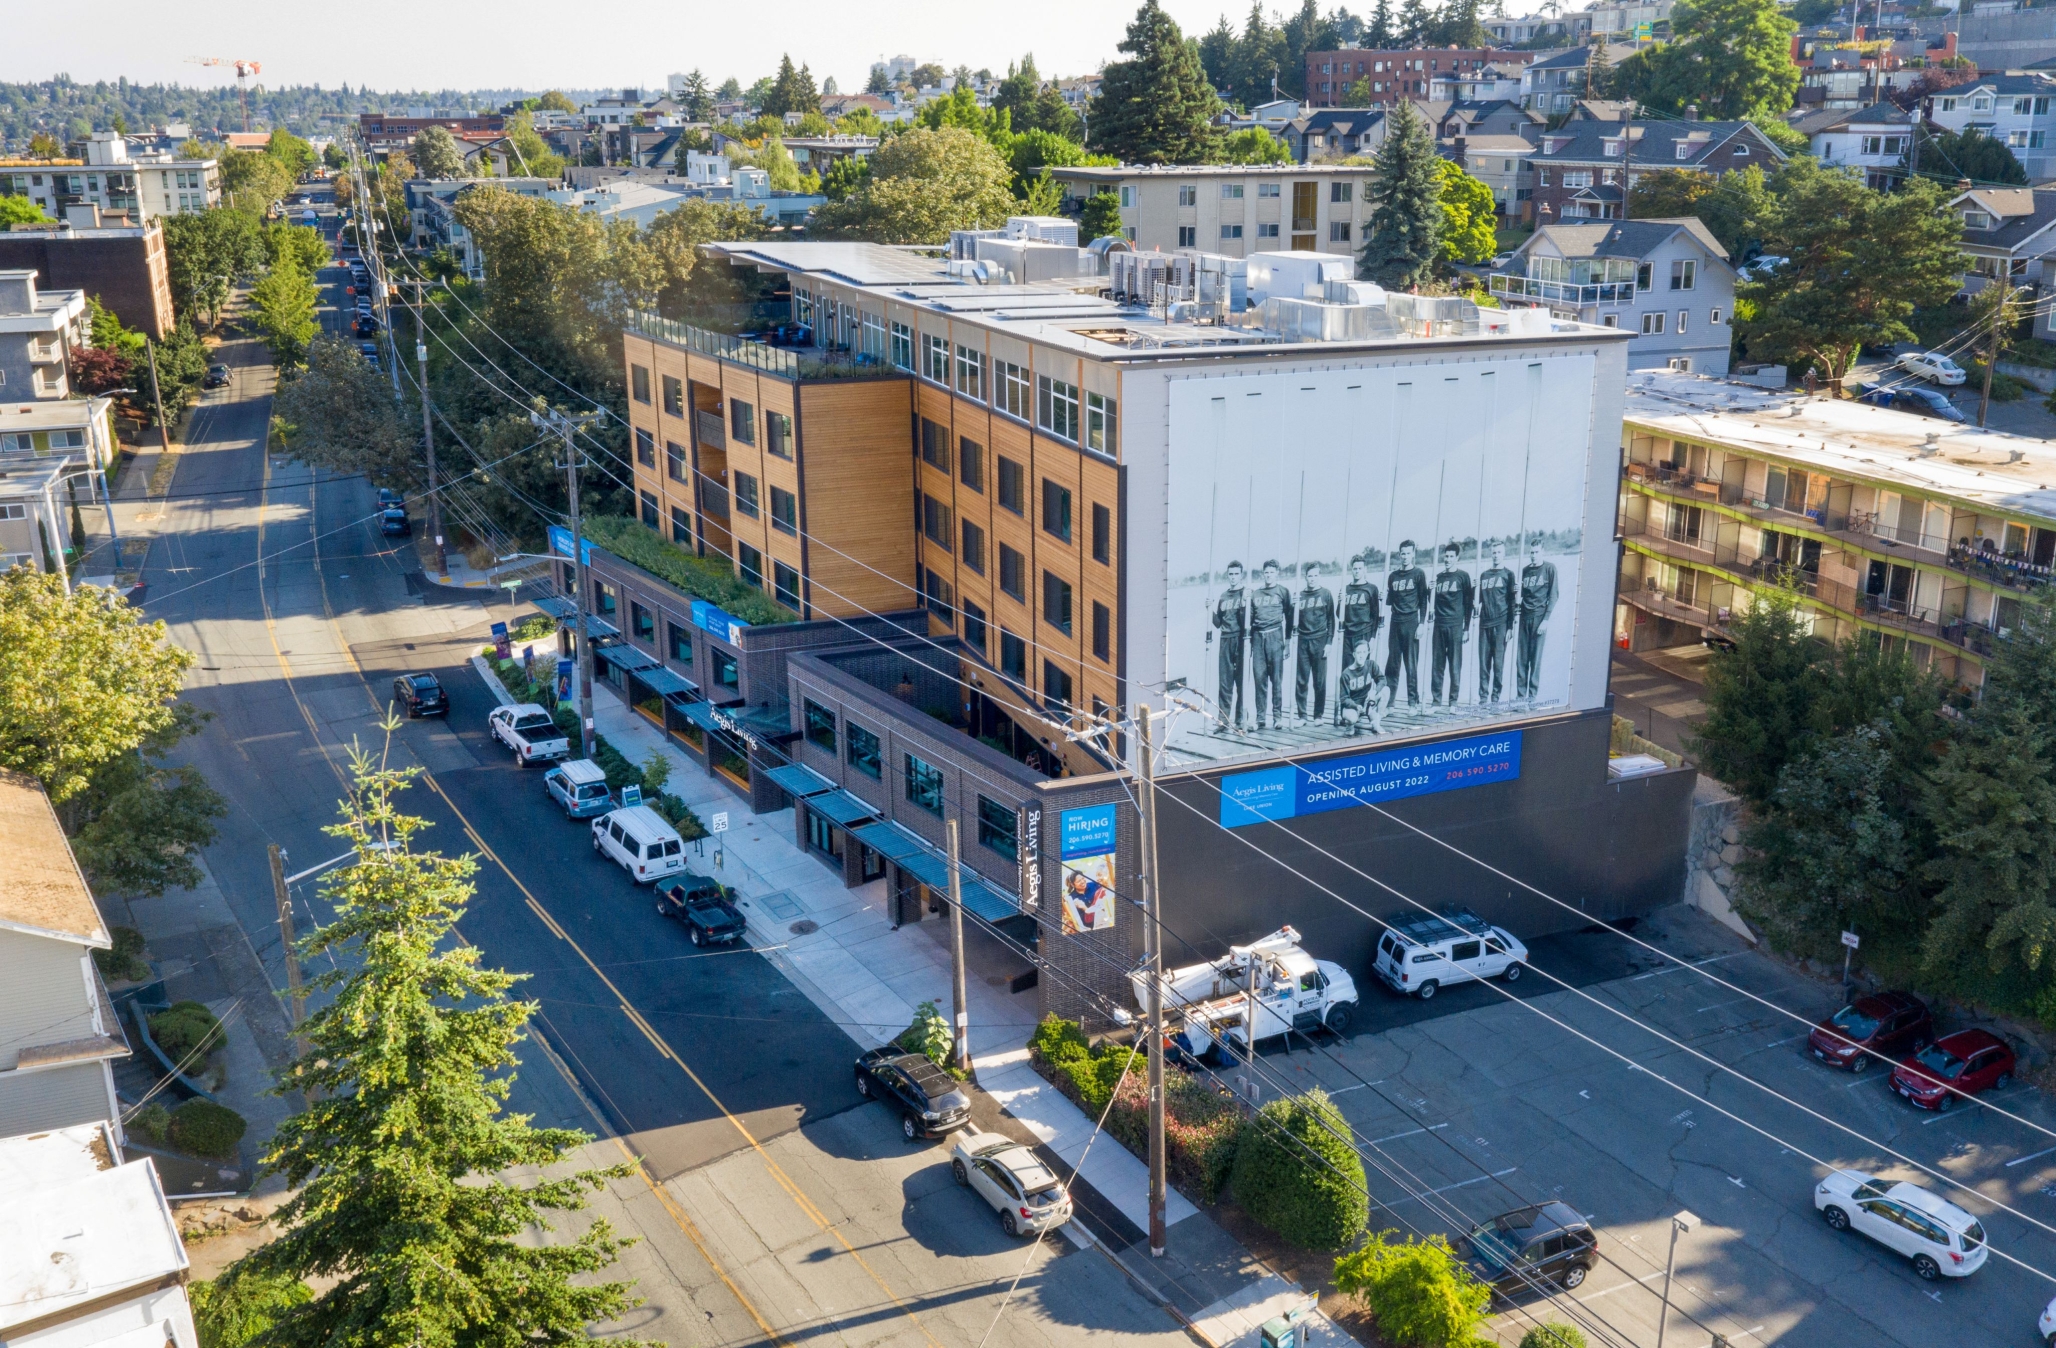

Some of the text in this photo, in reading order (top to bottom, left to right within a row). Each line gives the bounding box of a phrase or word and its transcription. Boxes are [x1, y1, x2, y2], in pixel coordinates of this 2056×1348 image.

[1392, 579, 1415, 592] USA
[1436, 581, 1458, 593] USA
[1481, 576, 1504, 590] USA
[1523, 575, 1545, 588] USA
[1254, 594, 1280, 607] USA
[1307, 741, 1511, 785] ASSISTED LIVING & MEMORY CARE
[1446, 762, 1510, 780] 206.590.5270
[1257, 782, 1285, 792] Living
[1306, 775, 1429, 803] OPENING AUGUST 2022
[714, 821, 727, 831] 25
[1068, 817, 1109, 832] HIRING
[1068, 832, 1109, 844] 206.590.5270
[1025, 810, 1042, 907] Aegis Living
